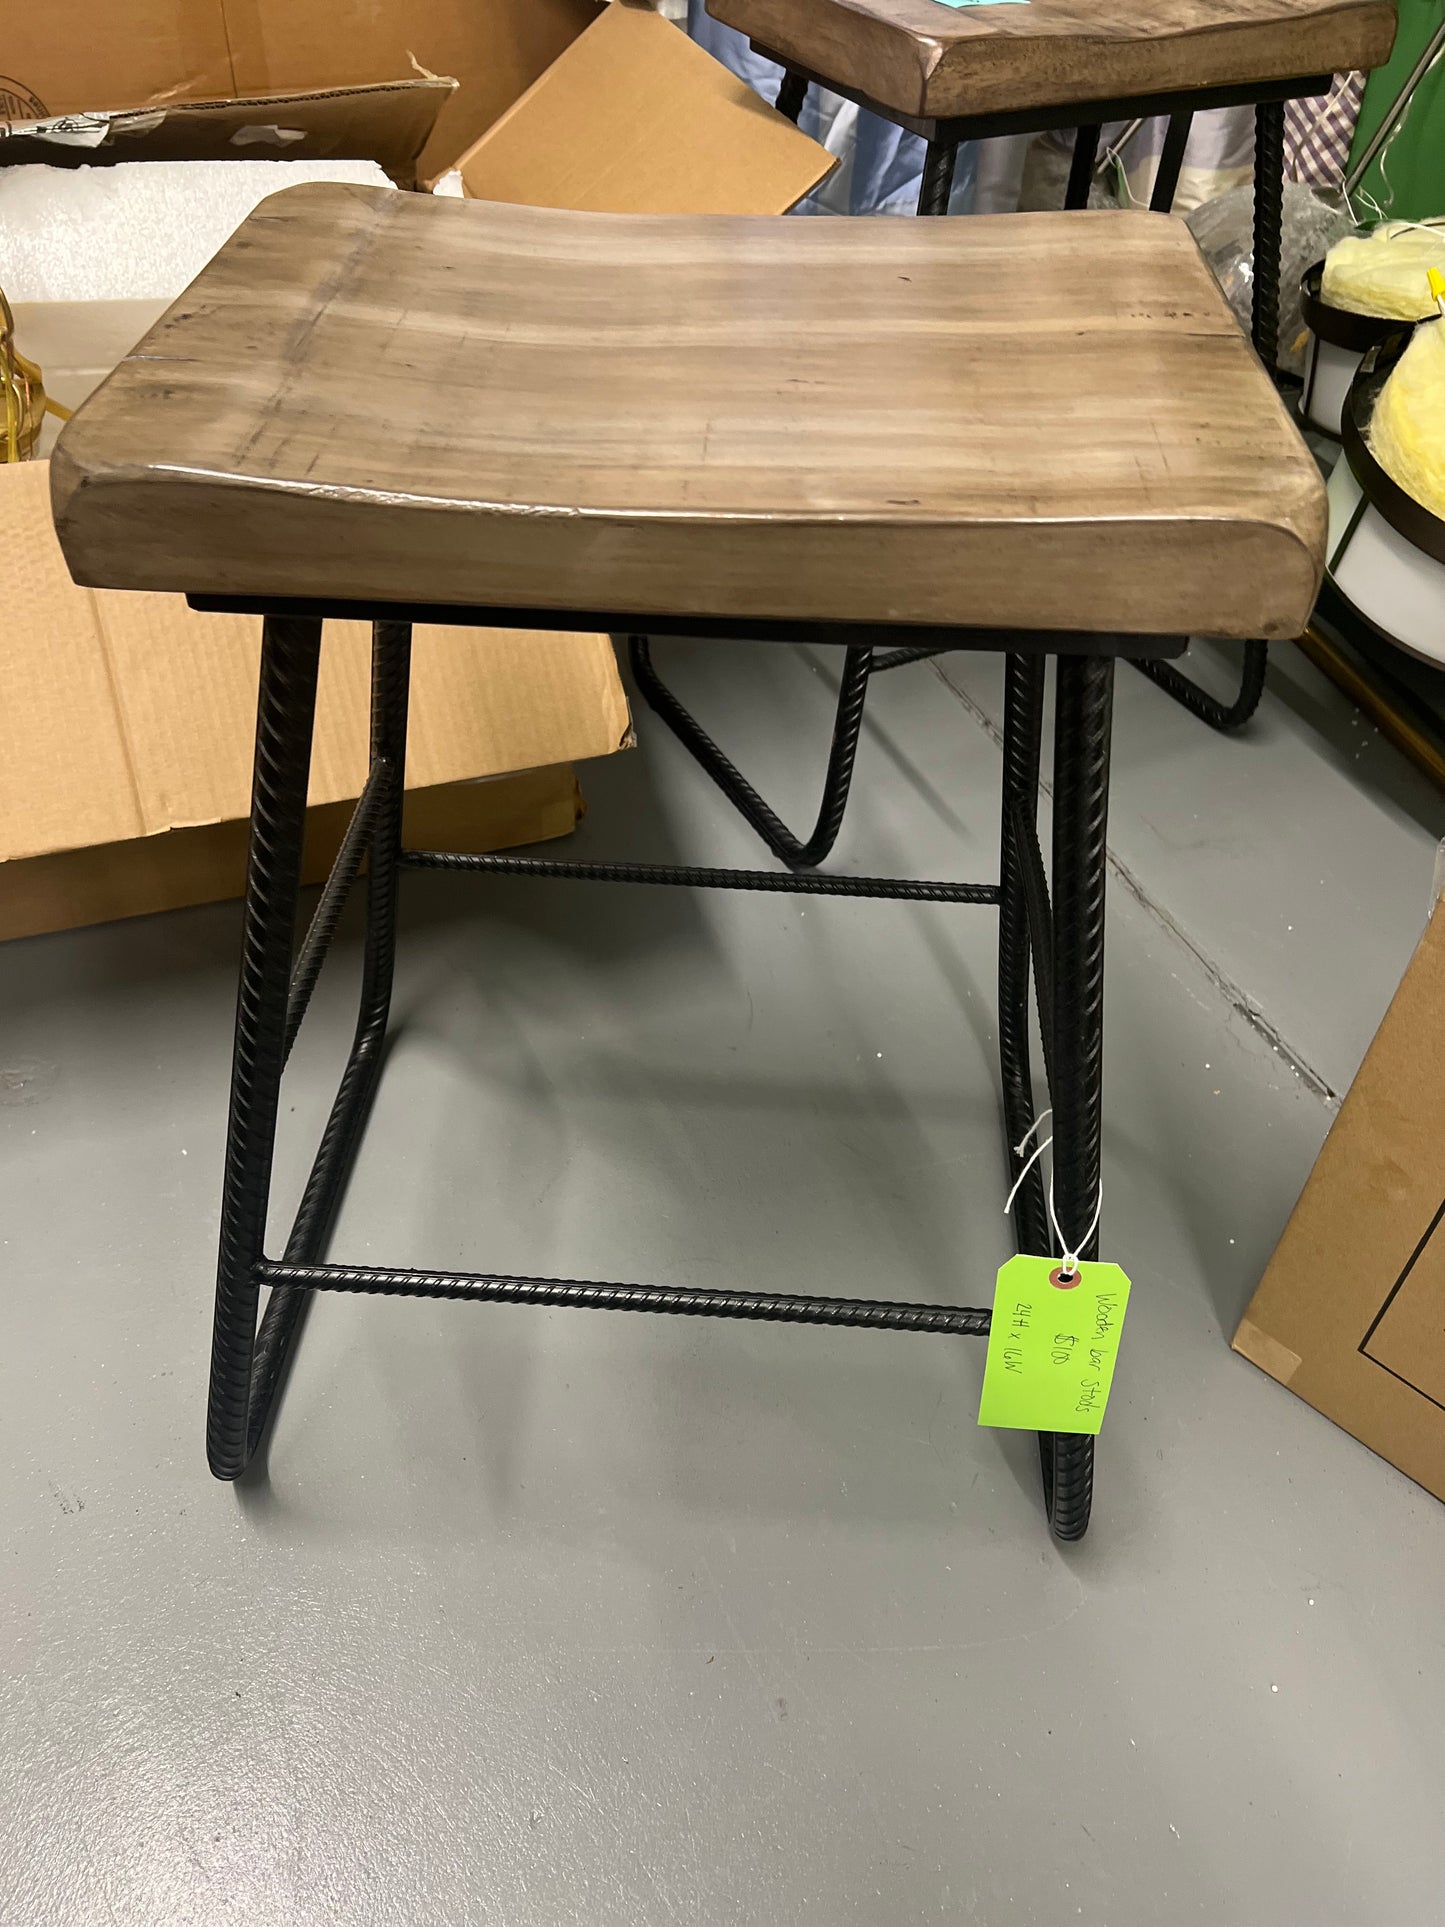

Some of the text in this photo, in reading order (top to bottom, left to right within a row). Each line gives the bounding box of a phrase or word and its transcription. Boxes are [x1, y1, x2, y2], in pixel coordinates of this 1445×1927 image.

[1091, 1293, 1119, 1340] Wooden
[1050, 1333, 1080, 1365] $100
[1089, 1348, 1110, 1372] bar
